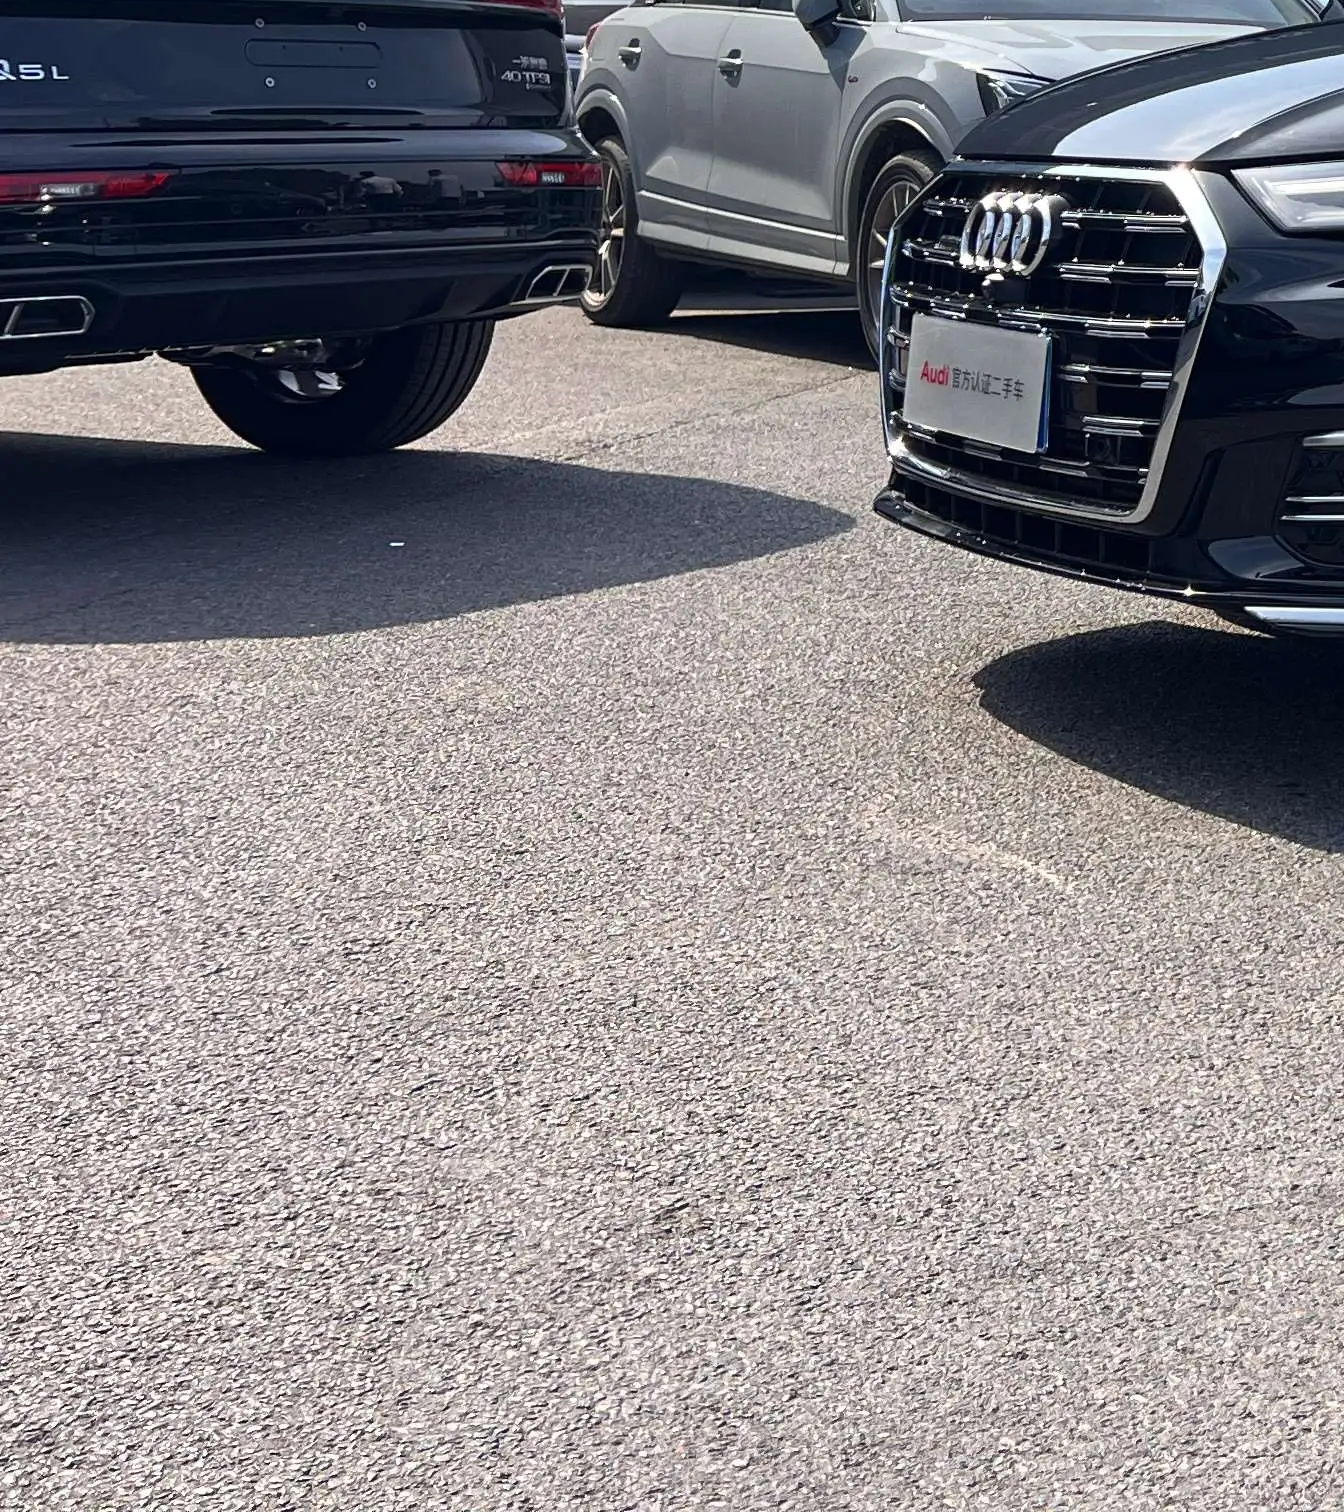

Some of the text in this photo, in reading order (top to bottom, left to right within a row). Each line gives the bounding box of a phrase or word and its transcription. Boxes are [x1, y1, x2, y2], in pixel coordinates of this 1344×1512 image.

[501, 70, 551, 85] 40 TFSI
[920, 360, 1025, 402] Audi 官方认证二手车
